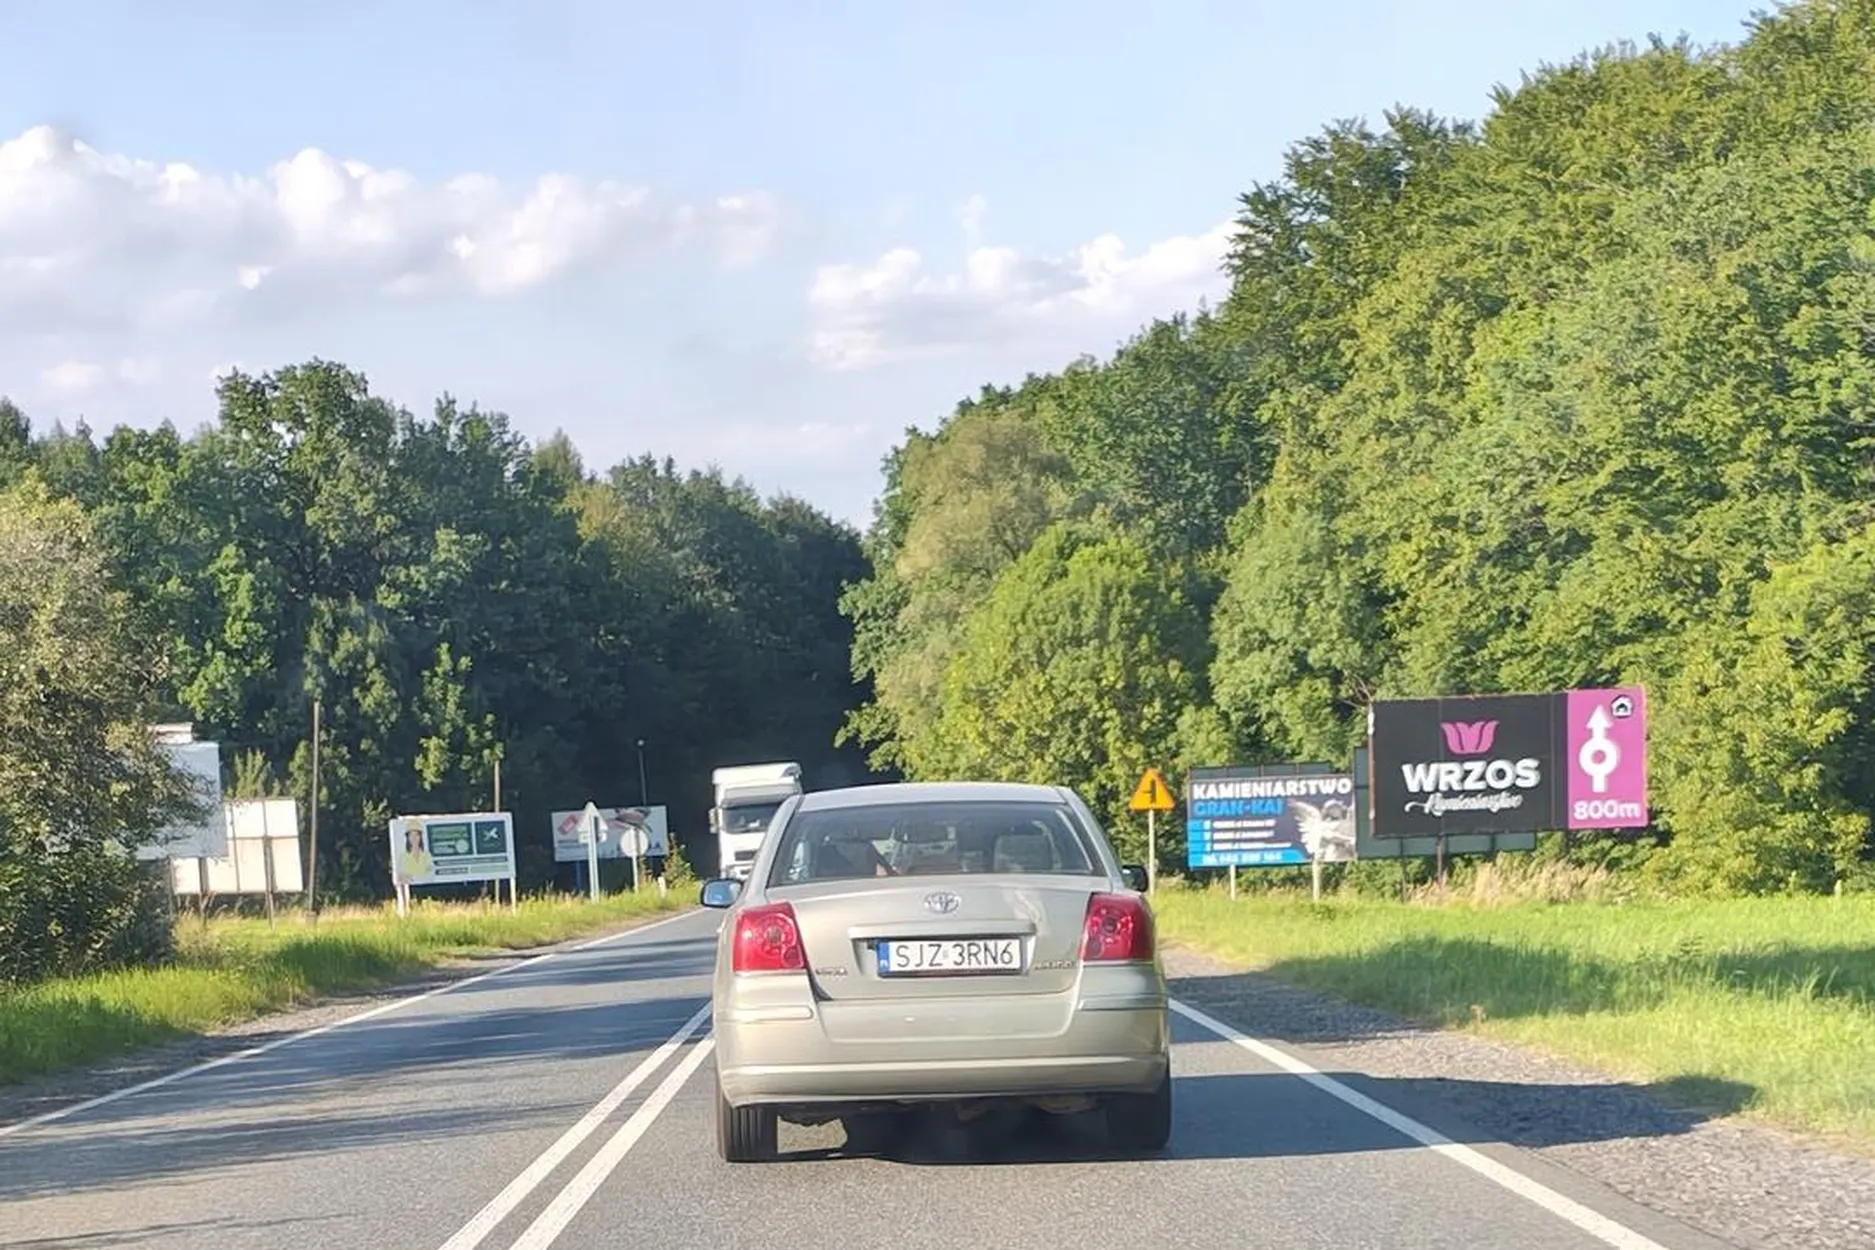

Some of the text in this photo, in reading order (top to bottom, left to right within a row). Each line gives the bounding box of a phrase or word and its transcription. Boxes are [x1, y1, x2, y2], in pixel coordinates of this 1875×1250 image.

[1401, 758, 1541, 792] WRZOS
[1193, 778, 1352, 799] KAMIENIARSTWO
[1573, 801, 1641, 820] 800m
[896, 943, 943, 967] SJZ
[952, 942, 1013, 966] 3RN6
